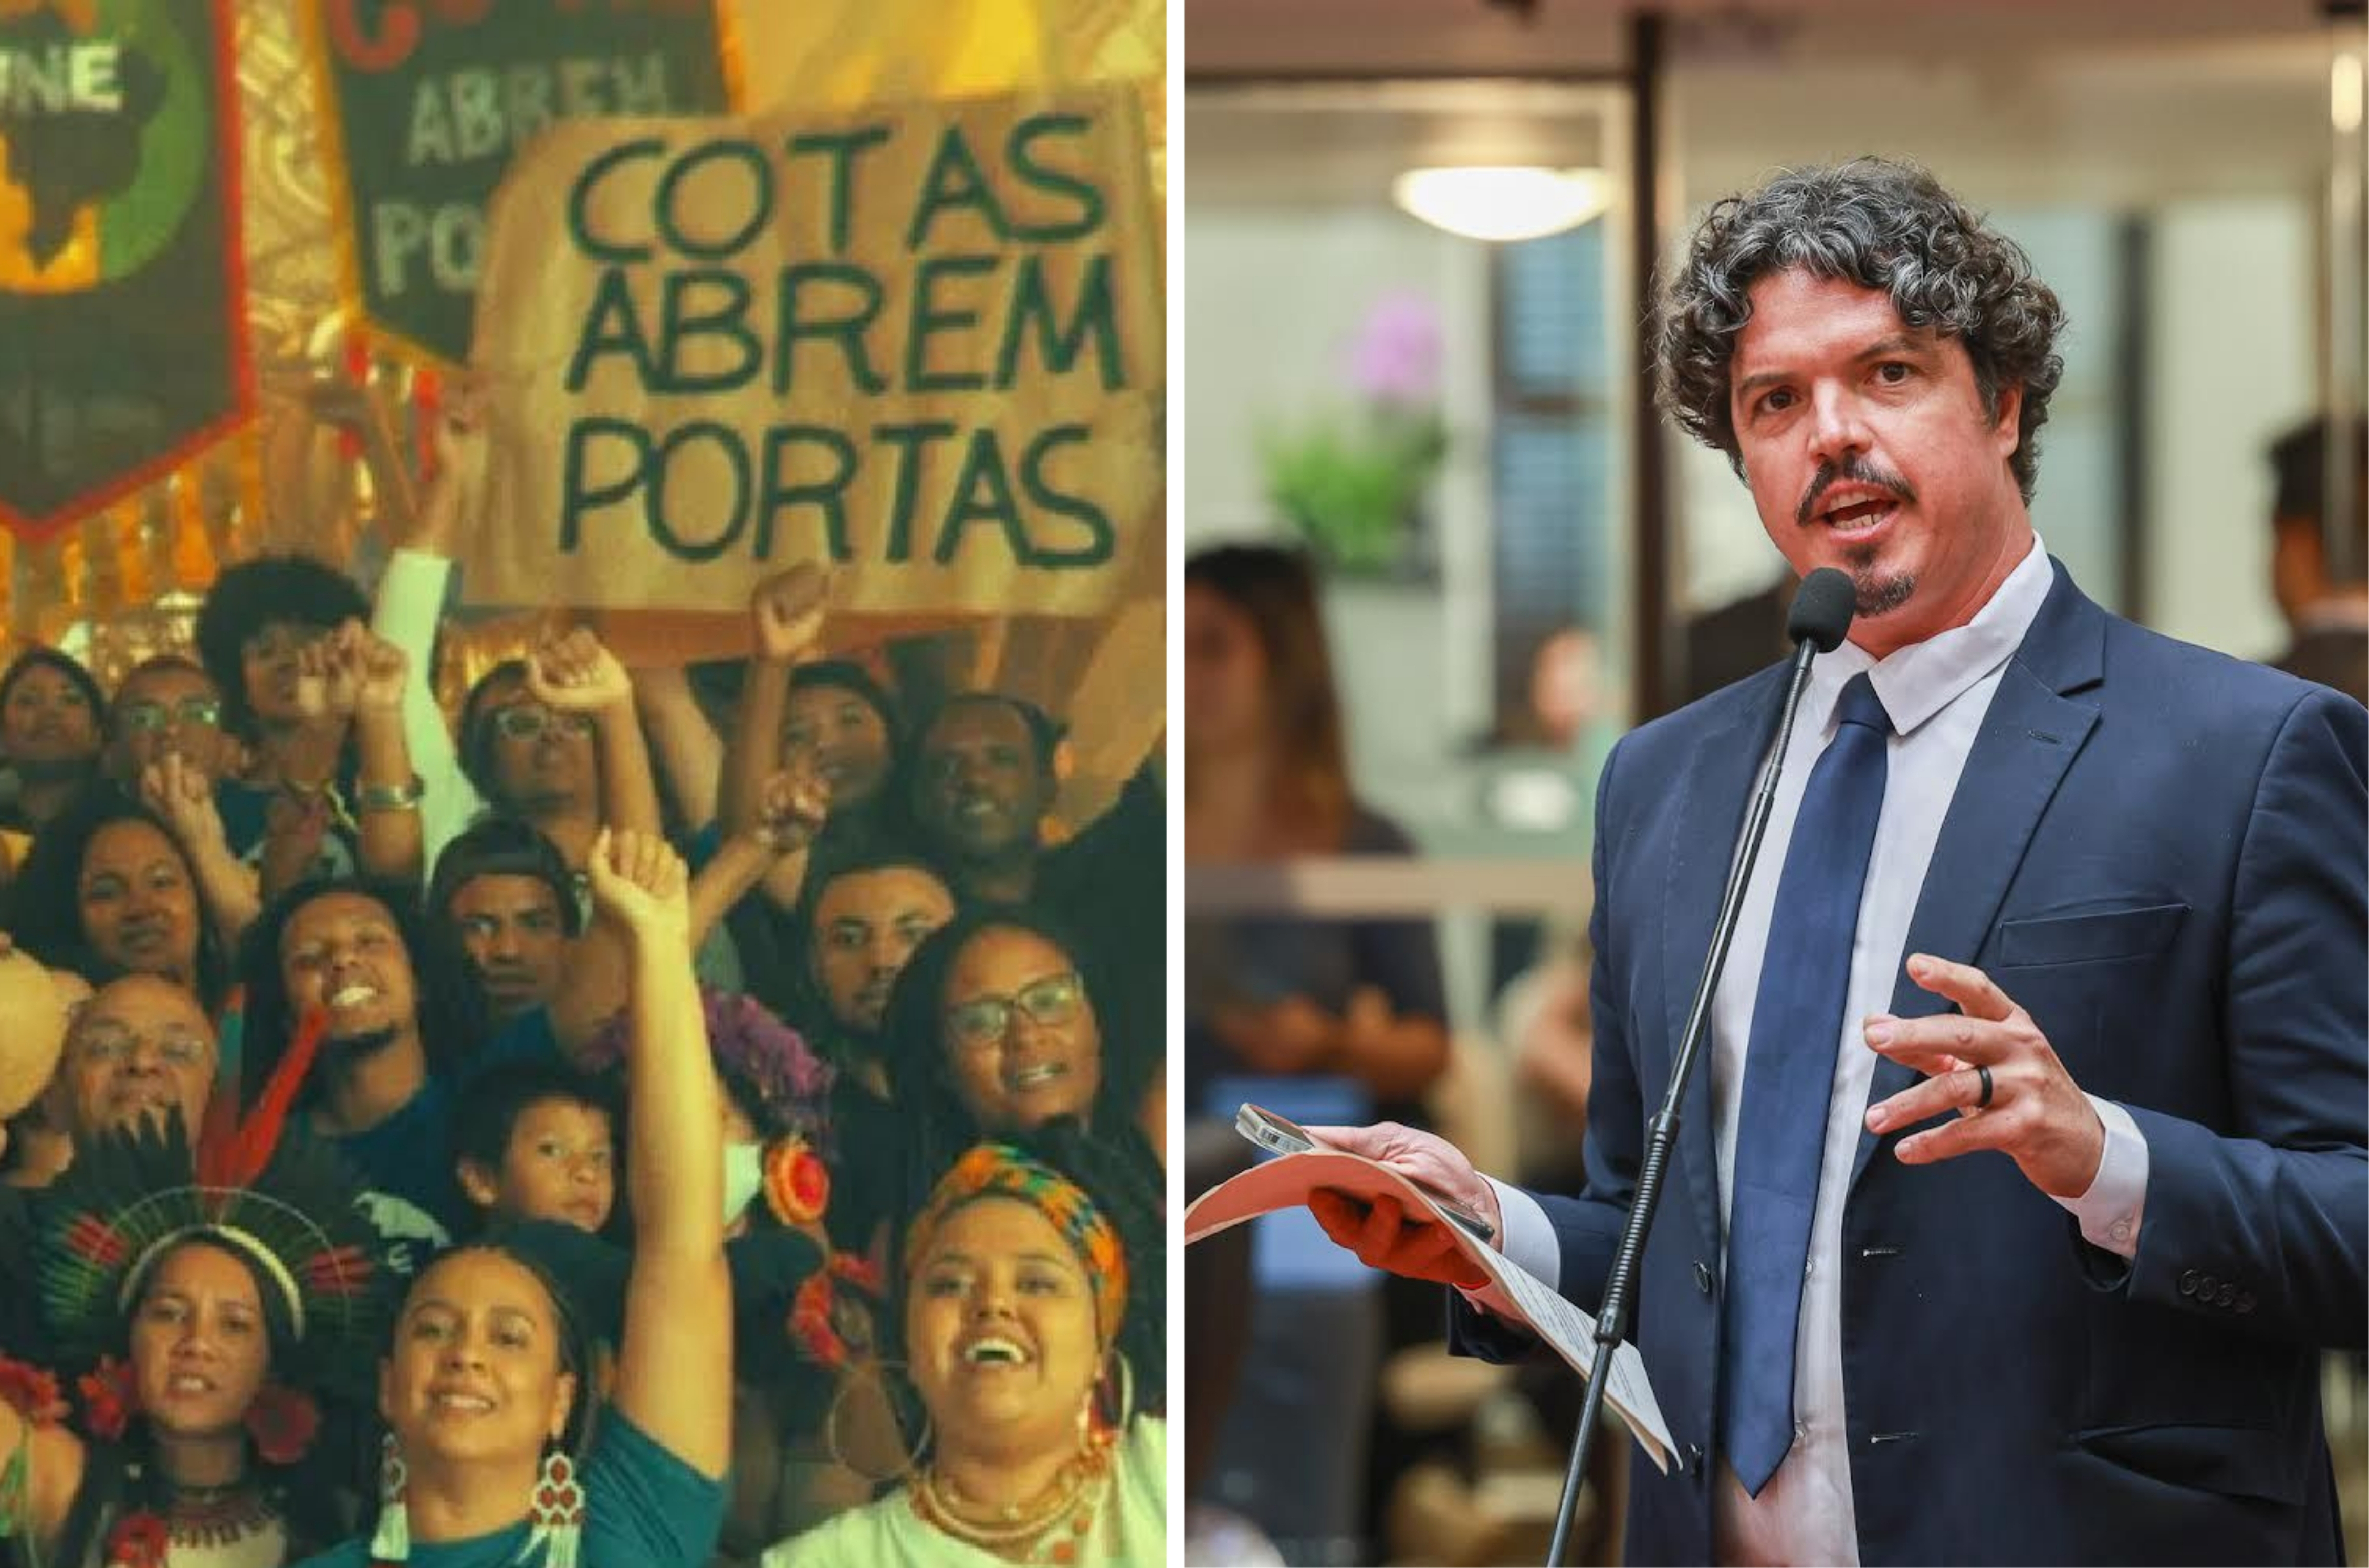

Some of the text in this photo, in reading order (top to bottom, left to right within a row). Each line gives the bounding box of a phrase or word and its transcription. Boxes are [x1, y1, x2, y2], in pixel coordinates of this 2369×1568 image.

[0, 44, 122, 111] NE
[565, 114, 1106, 263] COTAS
[564, 253, 1126, 397] ABREM
[558, 417, 1117, 568] PORTAS
